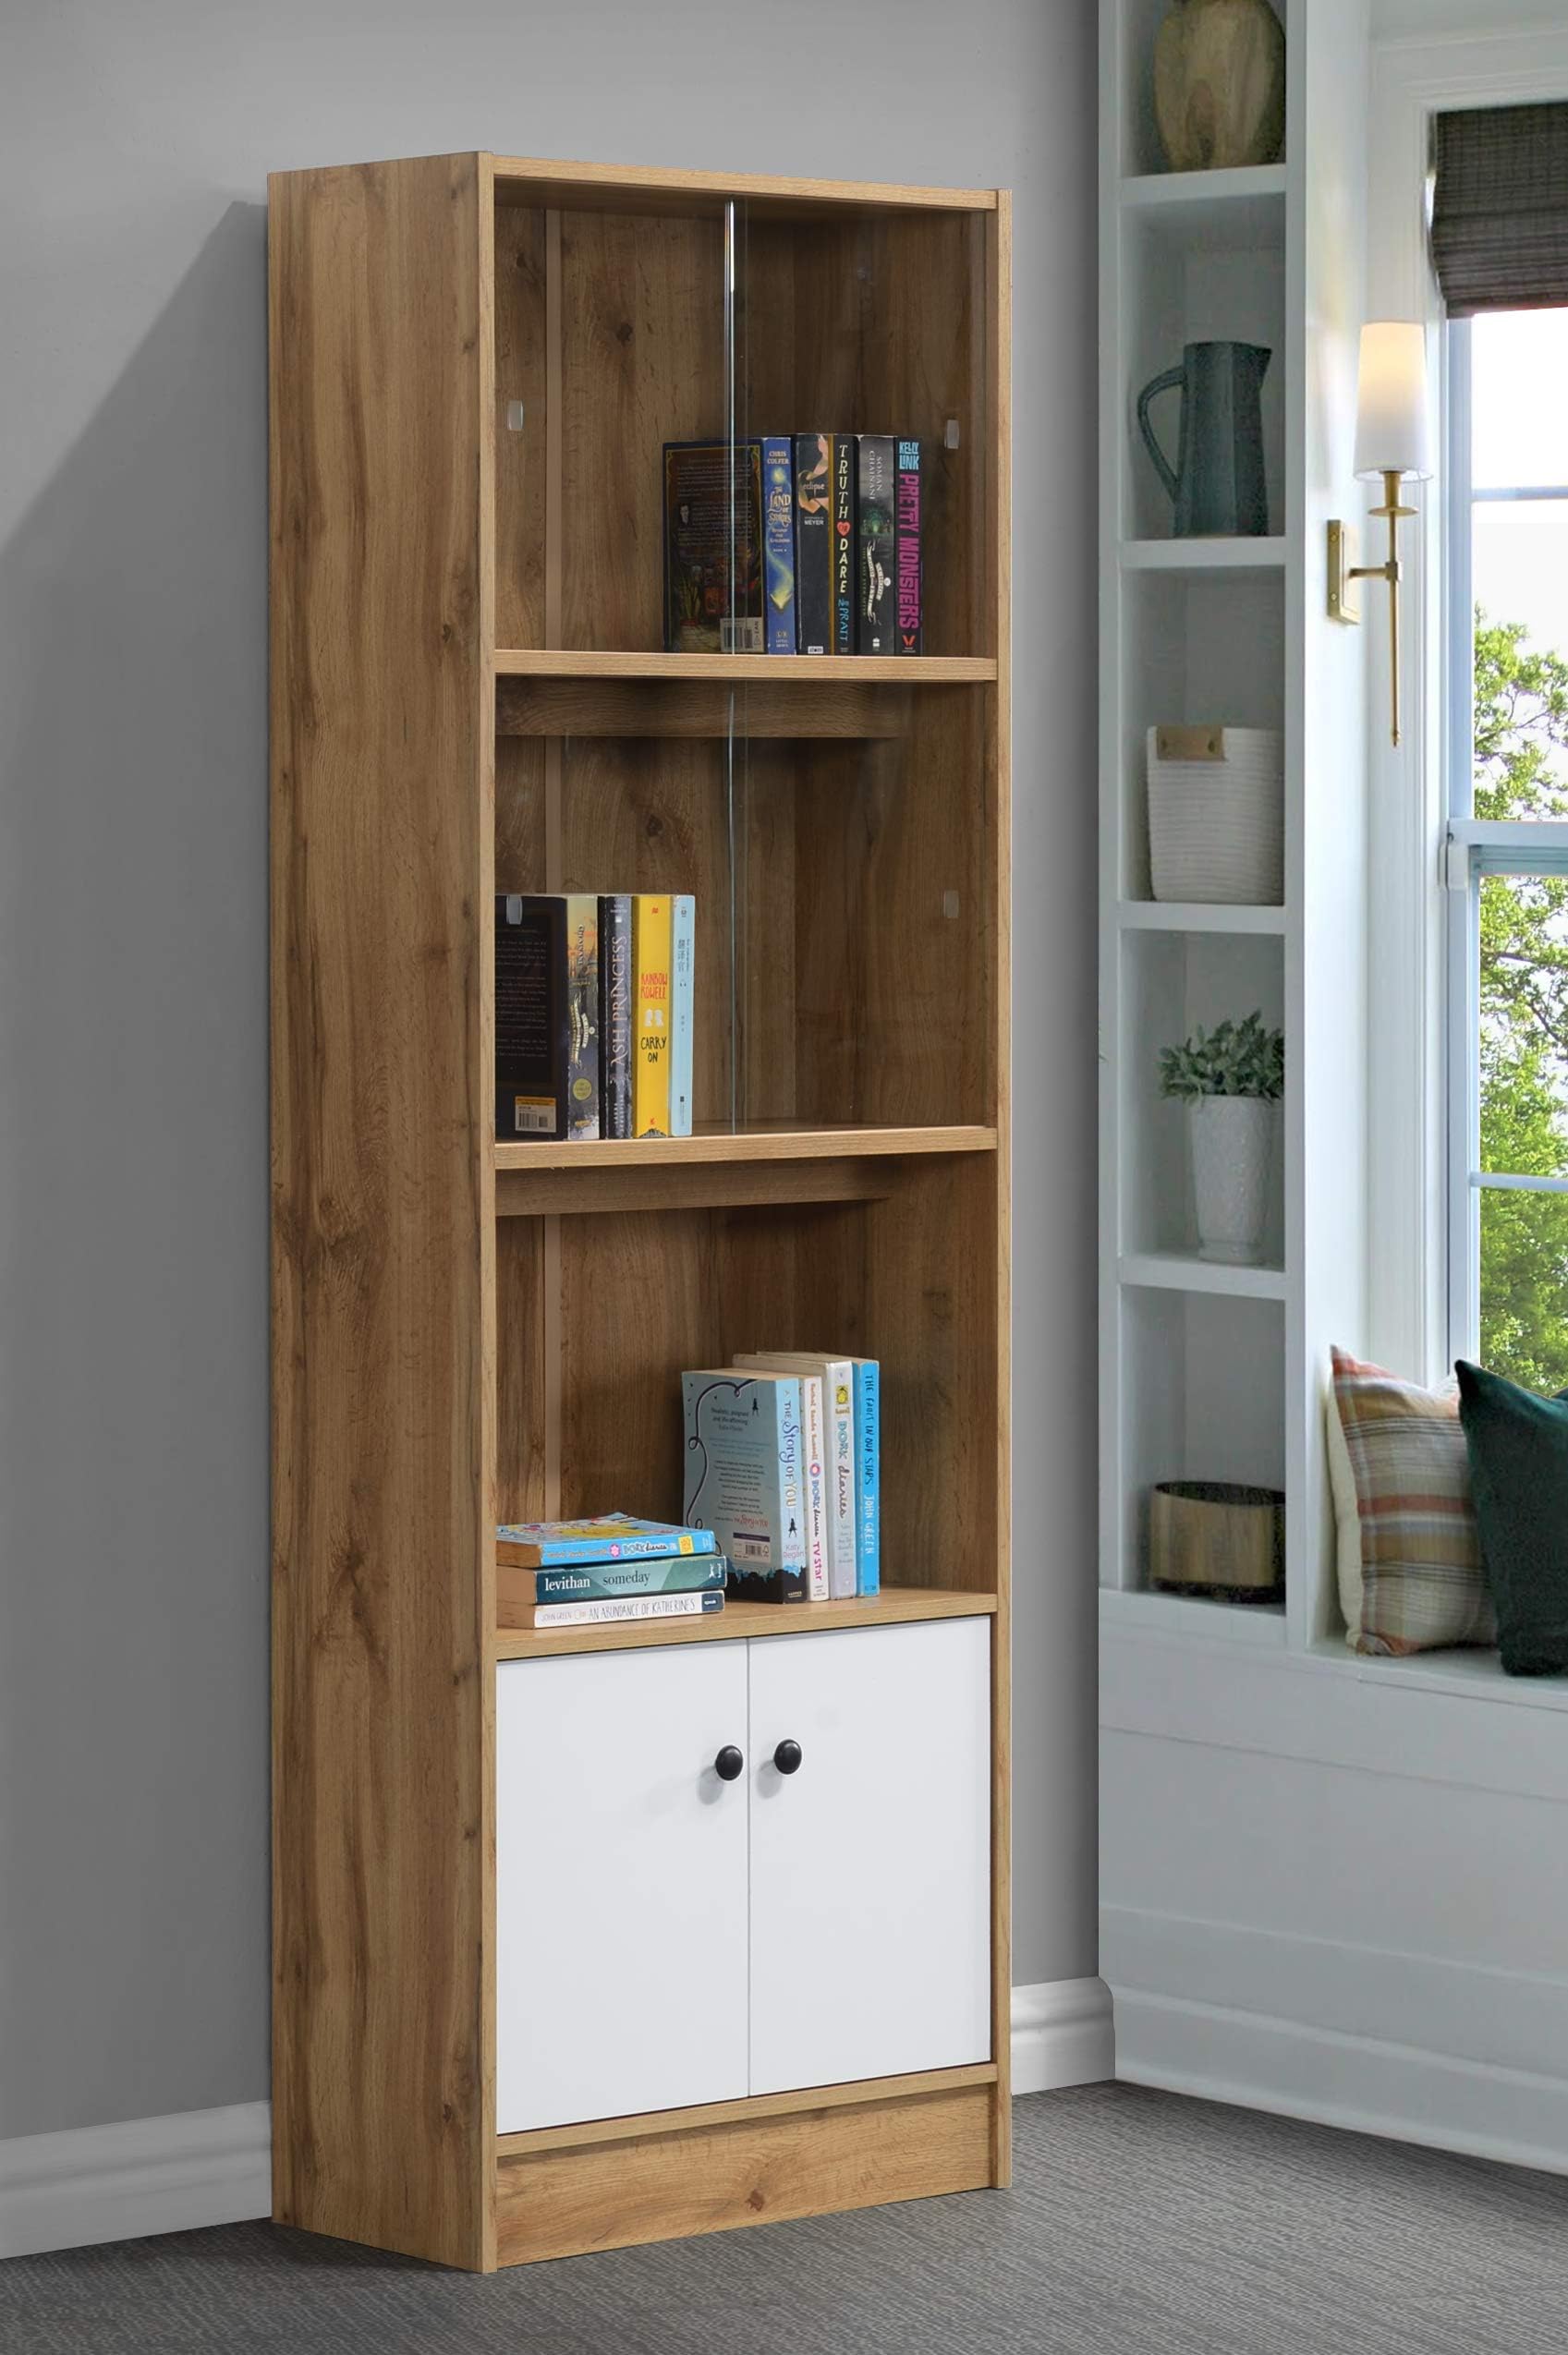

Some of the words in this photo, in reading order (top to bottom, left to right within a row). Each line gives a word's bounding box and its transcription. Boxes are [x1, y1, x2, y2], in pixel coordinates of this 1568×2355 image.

[899, 442, 919, 455] KELLY
[899, 455, 919, 470] LINK
[838, 444, 848, 518] TRUTH
[899, 474, 919, 532] PRETTY
[838, 538, 849, 593] DARE
[899, 537, 919, 629] MONSTERS
[611, 935, 628, 1022] PRINCESS
[641, 973, 667, 986] RAINBOW
[640, 986, 666, 999] ROWELL
[611, 1028, 628, 1067] ASH
[640, 1037, 666, 1050] CARRY
[647, 1052, 658, 1062] ON
[865, 1375, 874, 1392] THE
[780, 1420, 799, 1463] Story
[837, 1421, 848, 1460] DORK
[865, 1425, 873, 1436] IN
[784, 1480, 797, 1508] YOU
[838, 1465, 850, 1519] diaries
[864, 1495, 874, 1518] JOHN
[813, 1541, 820, 1556] TV
[864, 1522, 875, 1554] GREEN
[545, 1576, 590, 1591] levithan
[602, 1571, 650, 1586] someday
[589, 1608, 599, 1620] AN
[601, 1603, 639, 1619] ABUNDANCE
[642, 1603, 650, 1615] OF
[651, 1598, 696, 1614] KATHERINES
